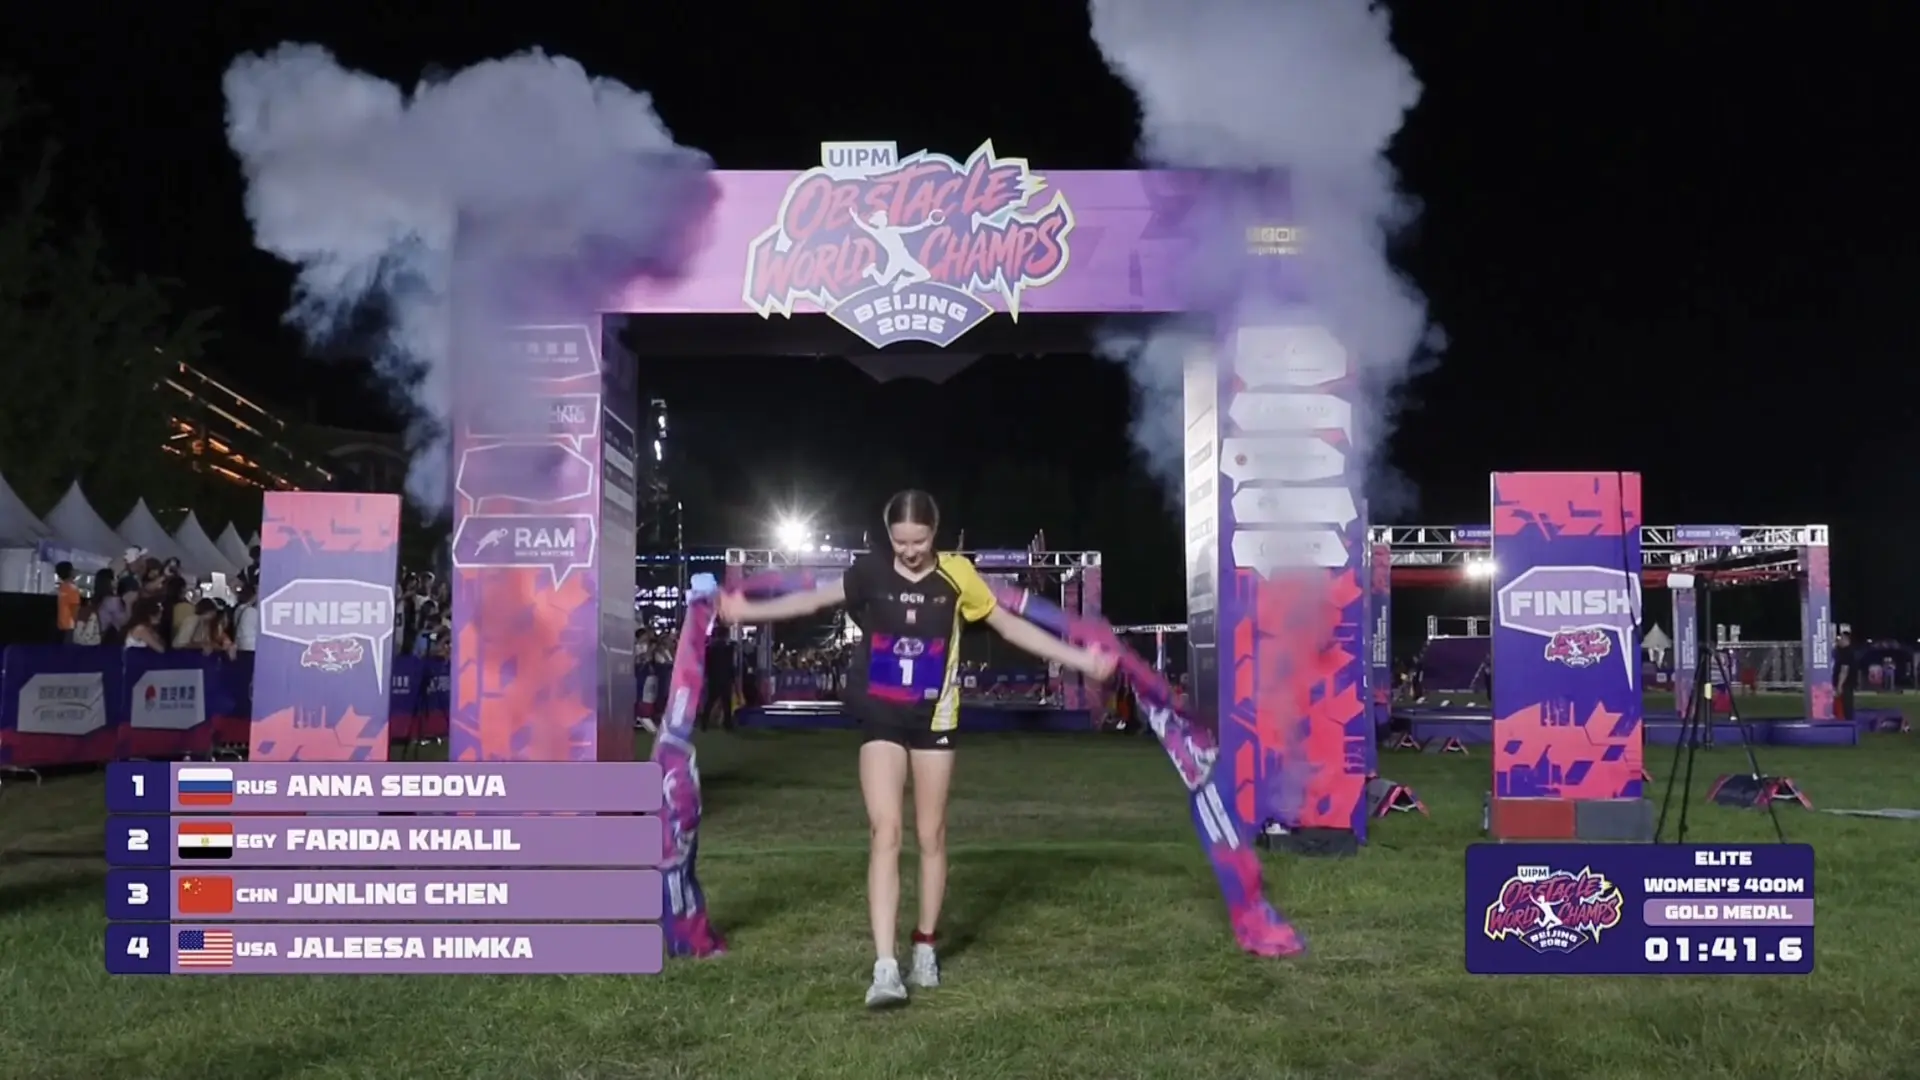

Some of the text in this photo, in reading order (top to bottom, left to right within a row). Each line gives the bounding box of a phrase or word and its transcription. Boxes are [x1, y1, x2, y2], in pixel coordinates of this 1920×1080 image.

[828, 148, 892, 167] UIPM
[786, 156, 1021, 242] OBSTACLE
[754, 214, 1063, 299] WORLD CHAMPS
[853, 293, 968, 324] BEIJING
[876, 313, 946, 336] 2026
[514, 527, 576, 549] RAM
[271, 601, 386, 625] FINISH
[1510, 588, 1631, 617] FINISH
[899, 658, 914, 686] 1
